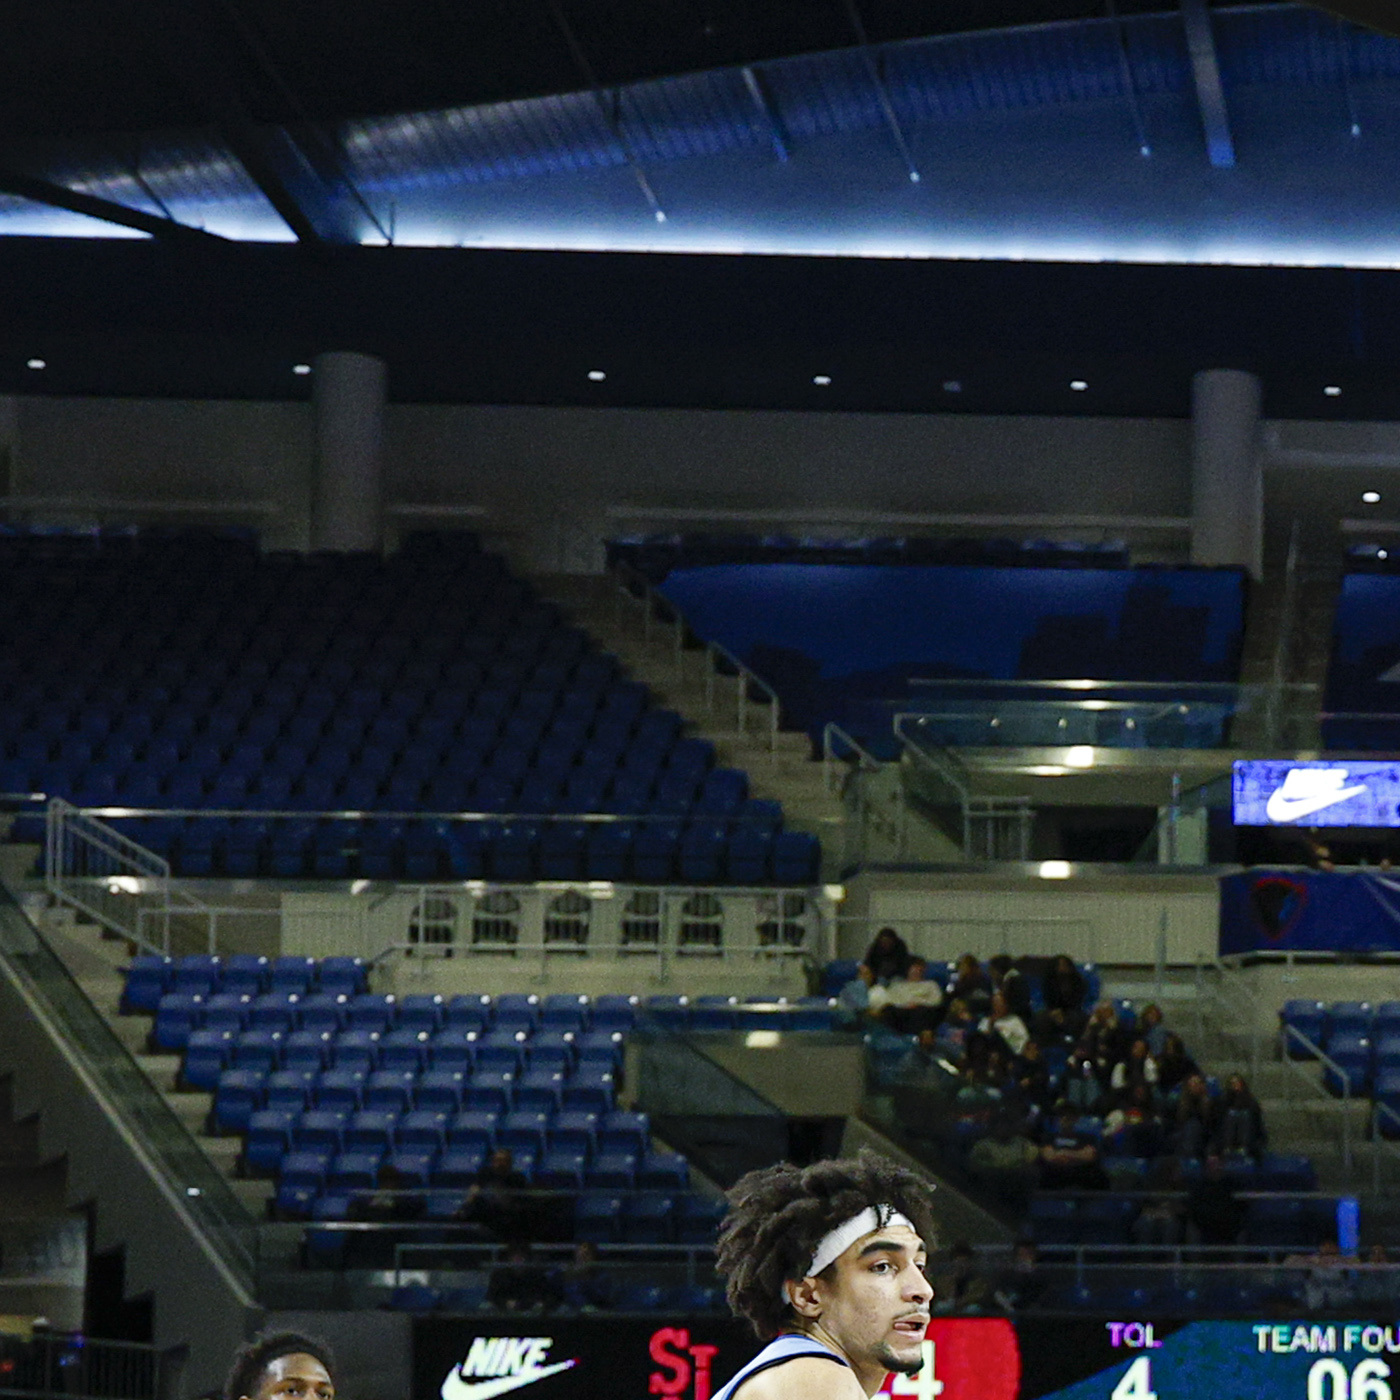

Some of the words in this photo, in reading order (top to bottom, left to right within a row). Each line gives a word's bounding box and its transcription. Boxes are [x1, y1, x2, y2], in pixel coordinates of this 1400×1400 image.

[1105, 1322, 1163, 1348] TOL
[1252, 1325, 1337, 1353] TEAM
[461, 1337, 553, 1377] NIKE
